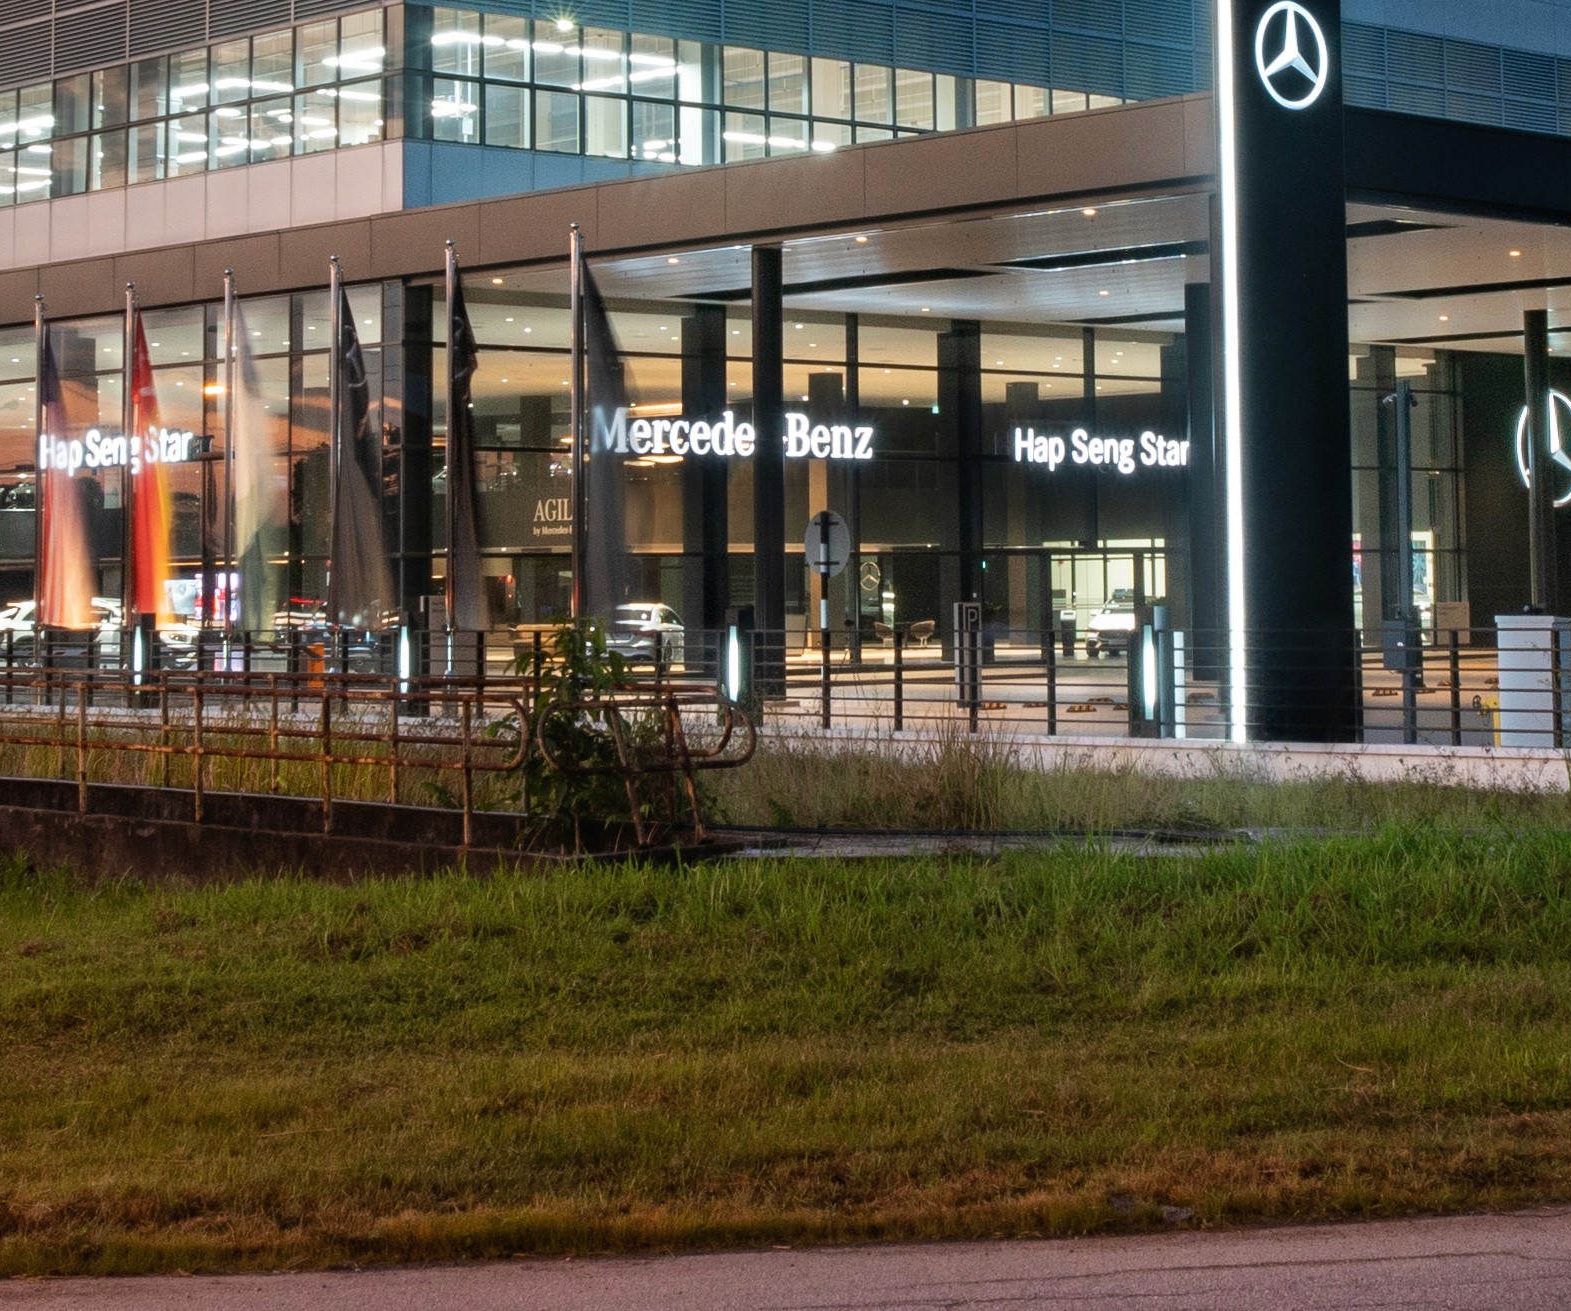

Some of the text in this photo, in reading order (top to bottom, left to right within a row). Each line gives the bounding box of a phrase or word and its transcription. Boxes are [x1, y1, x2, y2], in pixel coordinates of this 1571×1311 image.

[39, 434, 82, 477] Hap
[145, 426, 193, 463] Star
[590, 405, 875, 459] Mercede-Benz
[1014, 427, 1190, 474] Hap Seng Star
[533, 526, 541, 537] by
[967, 608, 978, 631] P
